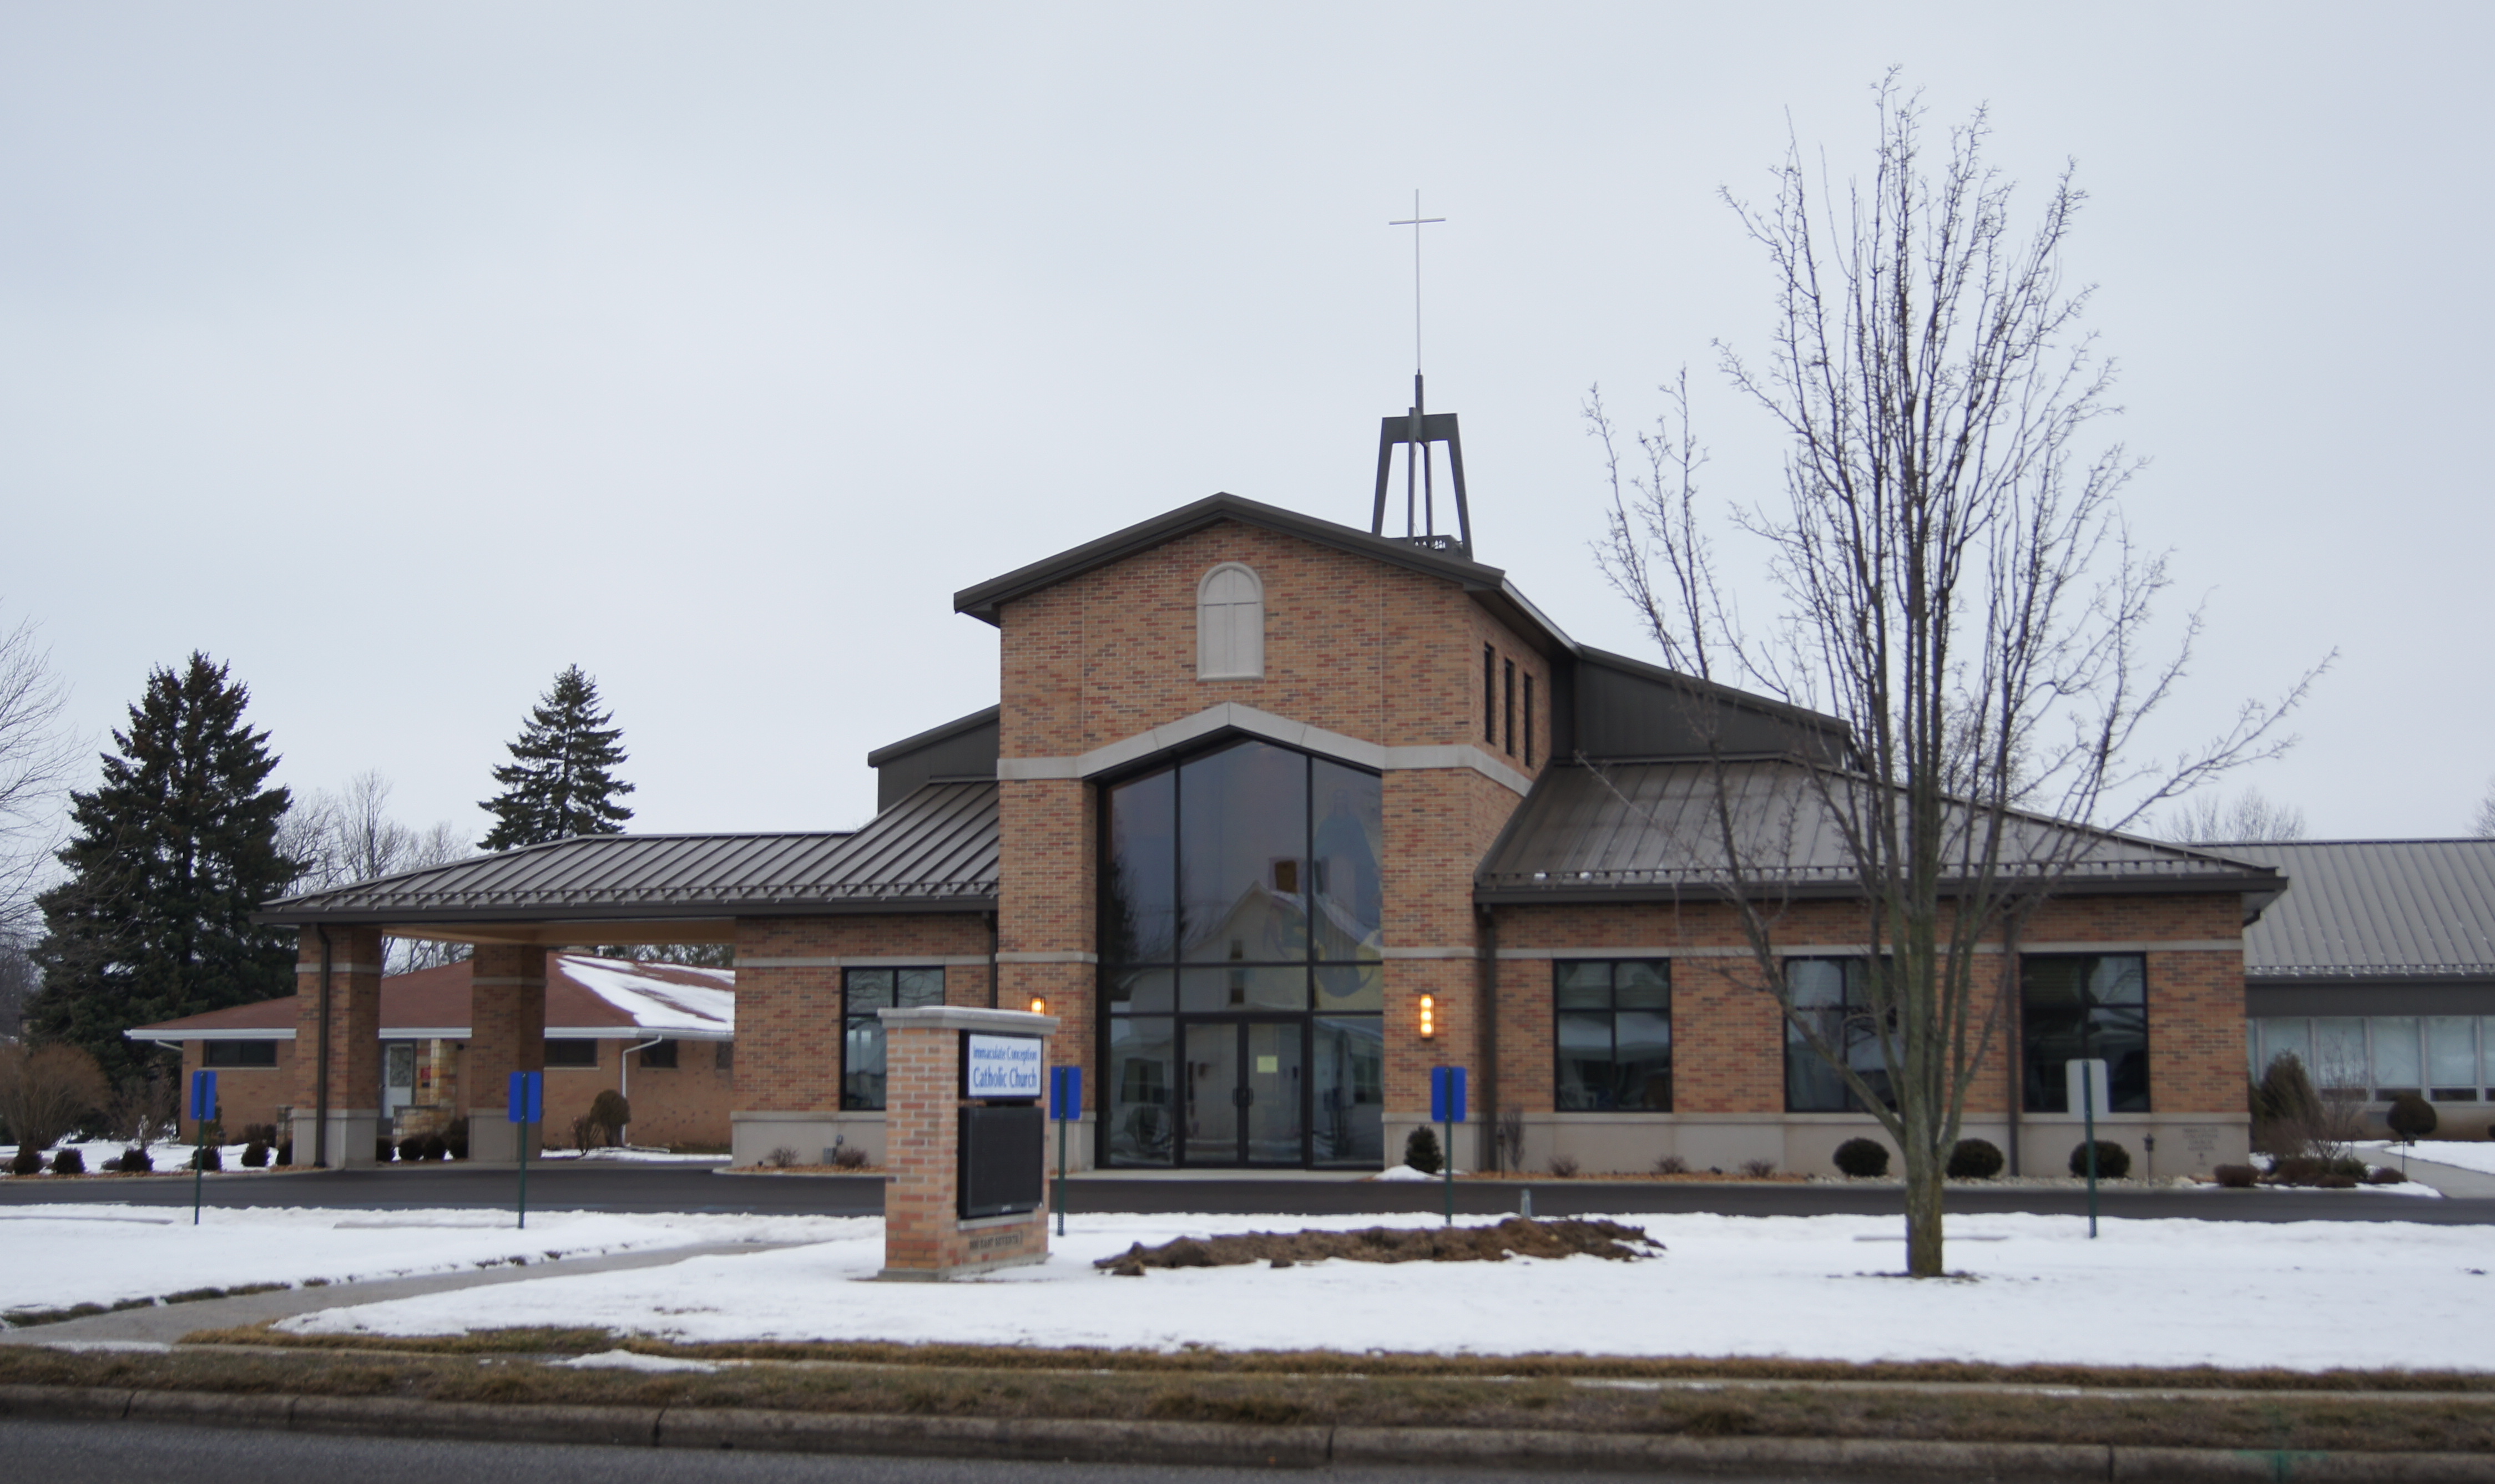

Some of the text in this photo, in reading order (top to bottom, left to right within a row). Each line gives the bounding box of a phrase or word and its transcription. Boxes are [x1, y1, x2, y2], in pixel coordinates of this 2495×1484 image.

[973, 1044, 1037, 1065] Immaculate Conception
[973, 1065, 1037, 1088] Catholic Church
